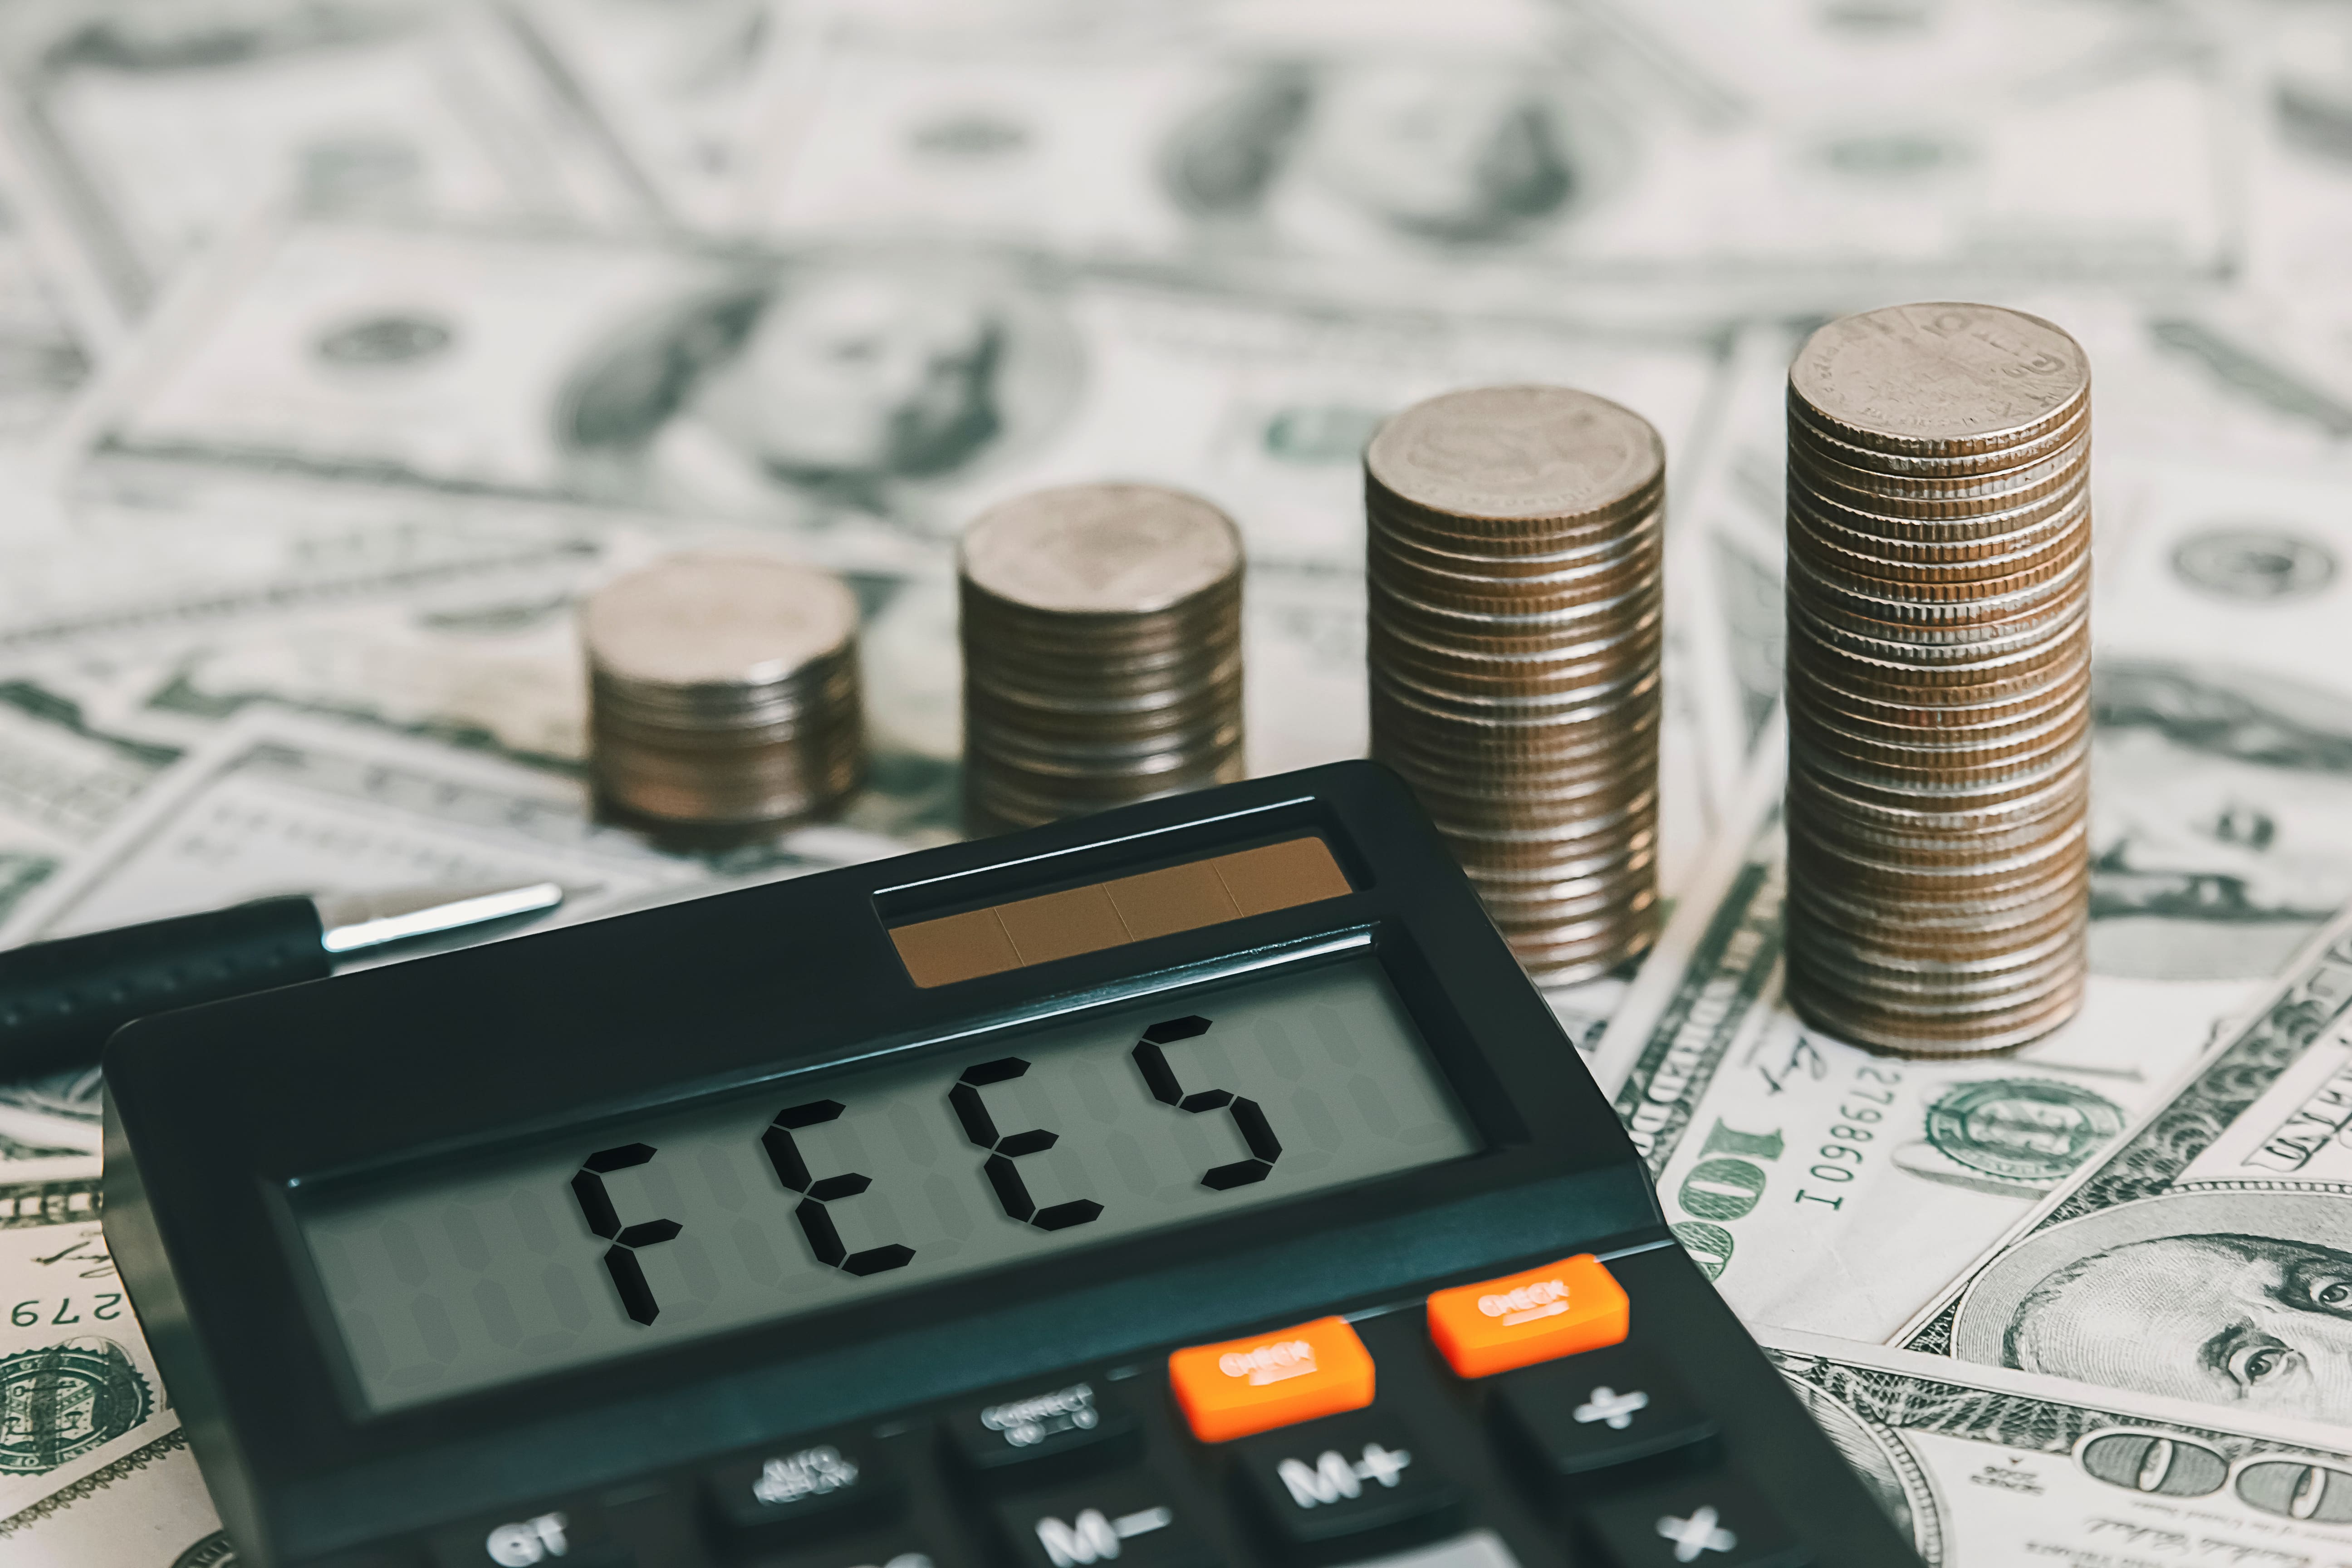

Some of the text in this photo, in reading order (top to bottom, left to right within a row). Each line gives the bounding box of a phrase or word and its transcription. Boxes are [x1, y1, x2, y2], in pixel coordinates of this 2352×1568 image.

[570, 1014, 1283, 1327] FEES
[11, 1293, 122, 1327] 279
[1276, 1442, 1411, 1509] M+
